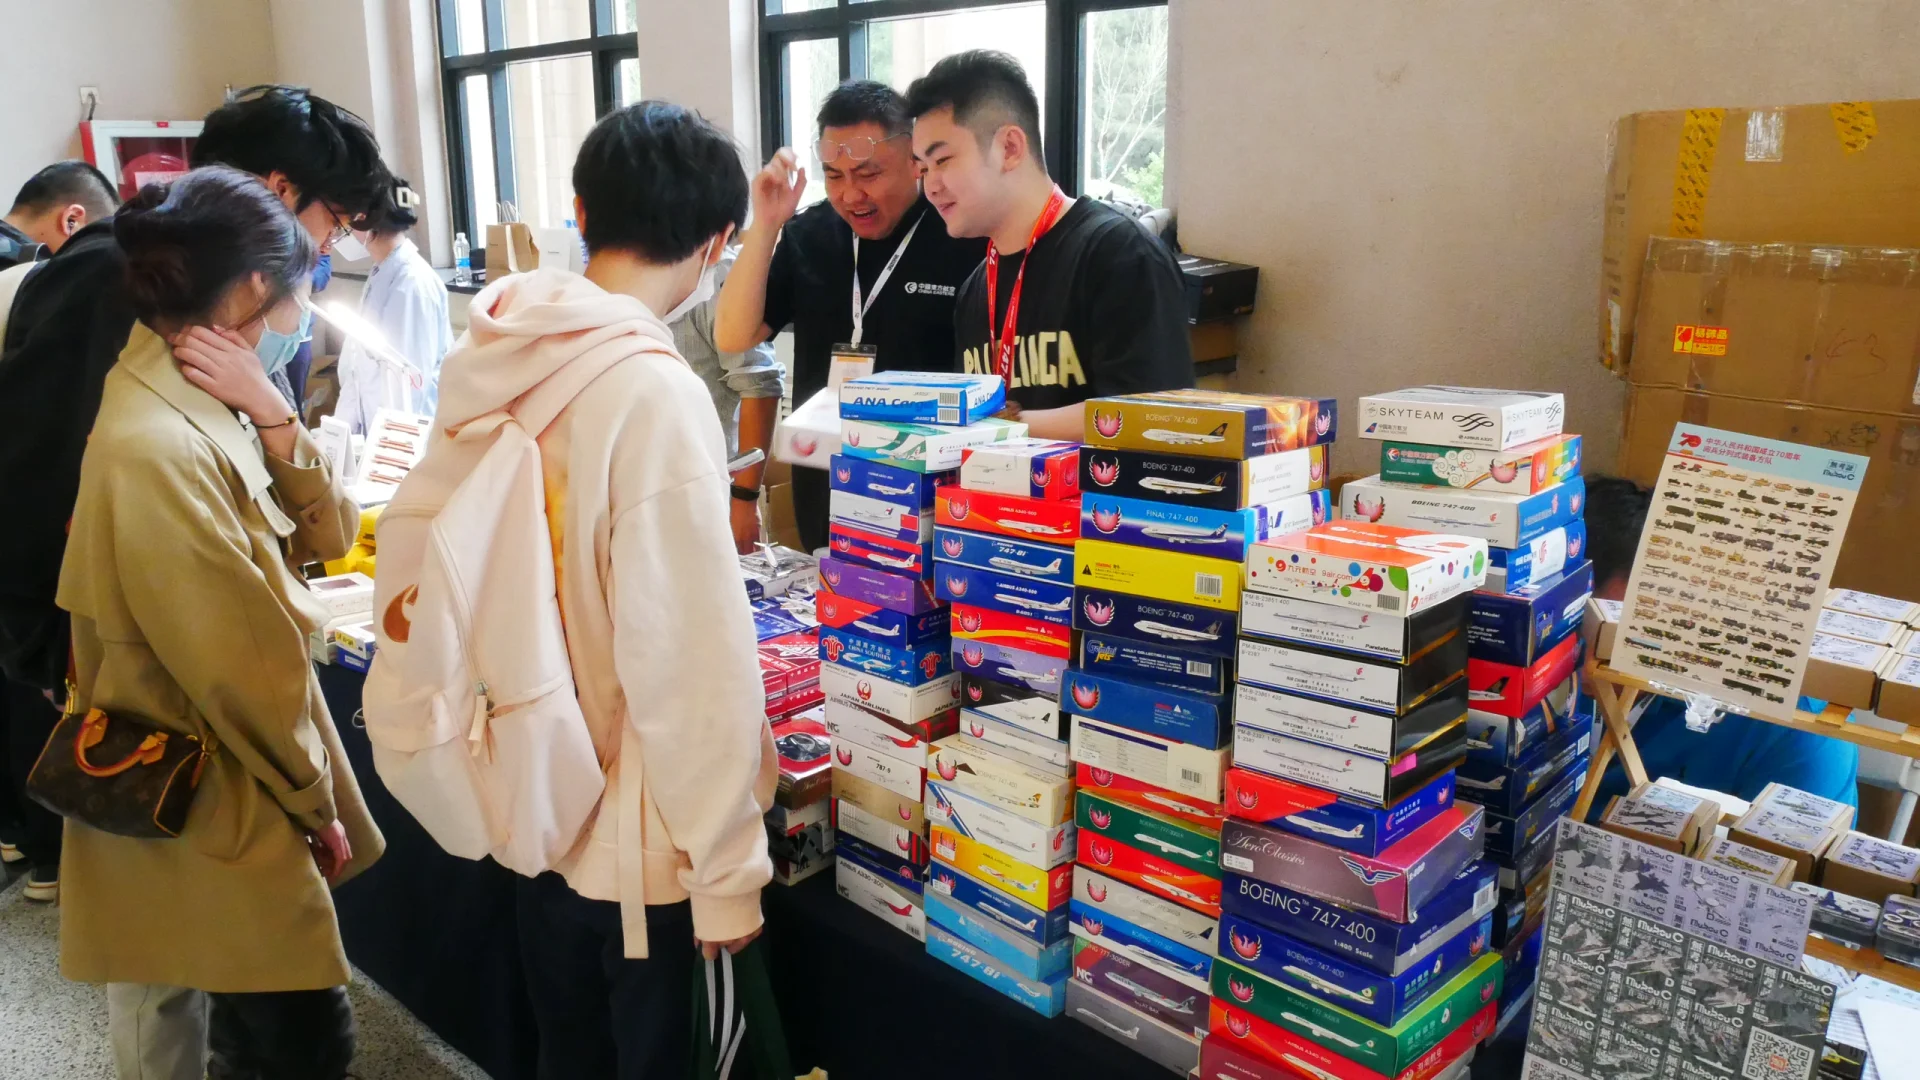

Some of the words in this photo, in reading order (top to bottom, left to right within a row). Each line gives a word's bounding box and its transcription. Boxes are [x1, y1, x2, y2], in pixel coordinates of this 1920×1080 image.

[851, 395, 888, 408] ANA
[1144, 413, 1170, 423] BOEING
[1172, 415, 1198, 425] 747-400
[1378, 406, 1444, 421] SKYTEAM
[1511, 407, 1543, 422] SKYTEAM
[1142, 460, 1168, 471] BOEING
[1169, 463, 1196, 474] 747-400
[1410, 499, 1441, 508] BOEING
[1442, 502, 1476, 511] 747-400
[1145, 509, 1166, 519] FINAL
[1168, 511, 1198, 523] 747-400
[1321, 570, 1353, 581] 9air.com
[1137, 604, 1164, 617] BOEING
[1167, 609, 1194, 621] 747-400
[1364, 642, 1401, 654] PandaModel
[839, 691, 860, 703] JAPAN
[860, 699, 891, 714] AIRLINES
[933, 701, 954, 713] JAPAN
[1359, 694, 1396, 707] PandaModel
[1353, 743, 1388, 756] PandaModel
[1348, 786, 1382, 799] PandaModel
[1226, 828, 1306, 866] AeroClassics
[1311, 905, 1376, 943] 747-400
[1354, 945, 1374, 959] Scale
[1286, 948, 1314, 966] BOEING
[1316, 961, 1345, 979] 747-400
[1664, 977, 1674, 987] D
[1736, 1004, 1745, 1014] B
